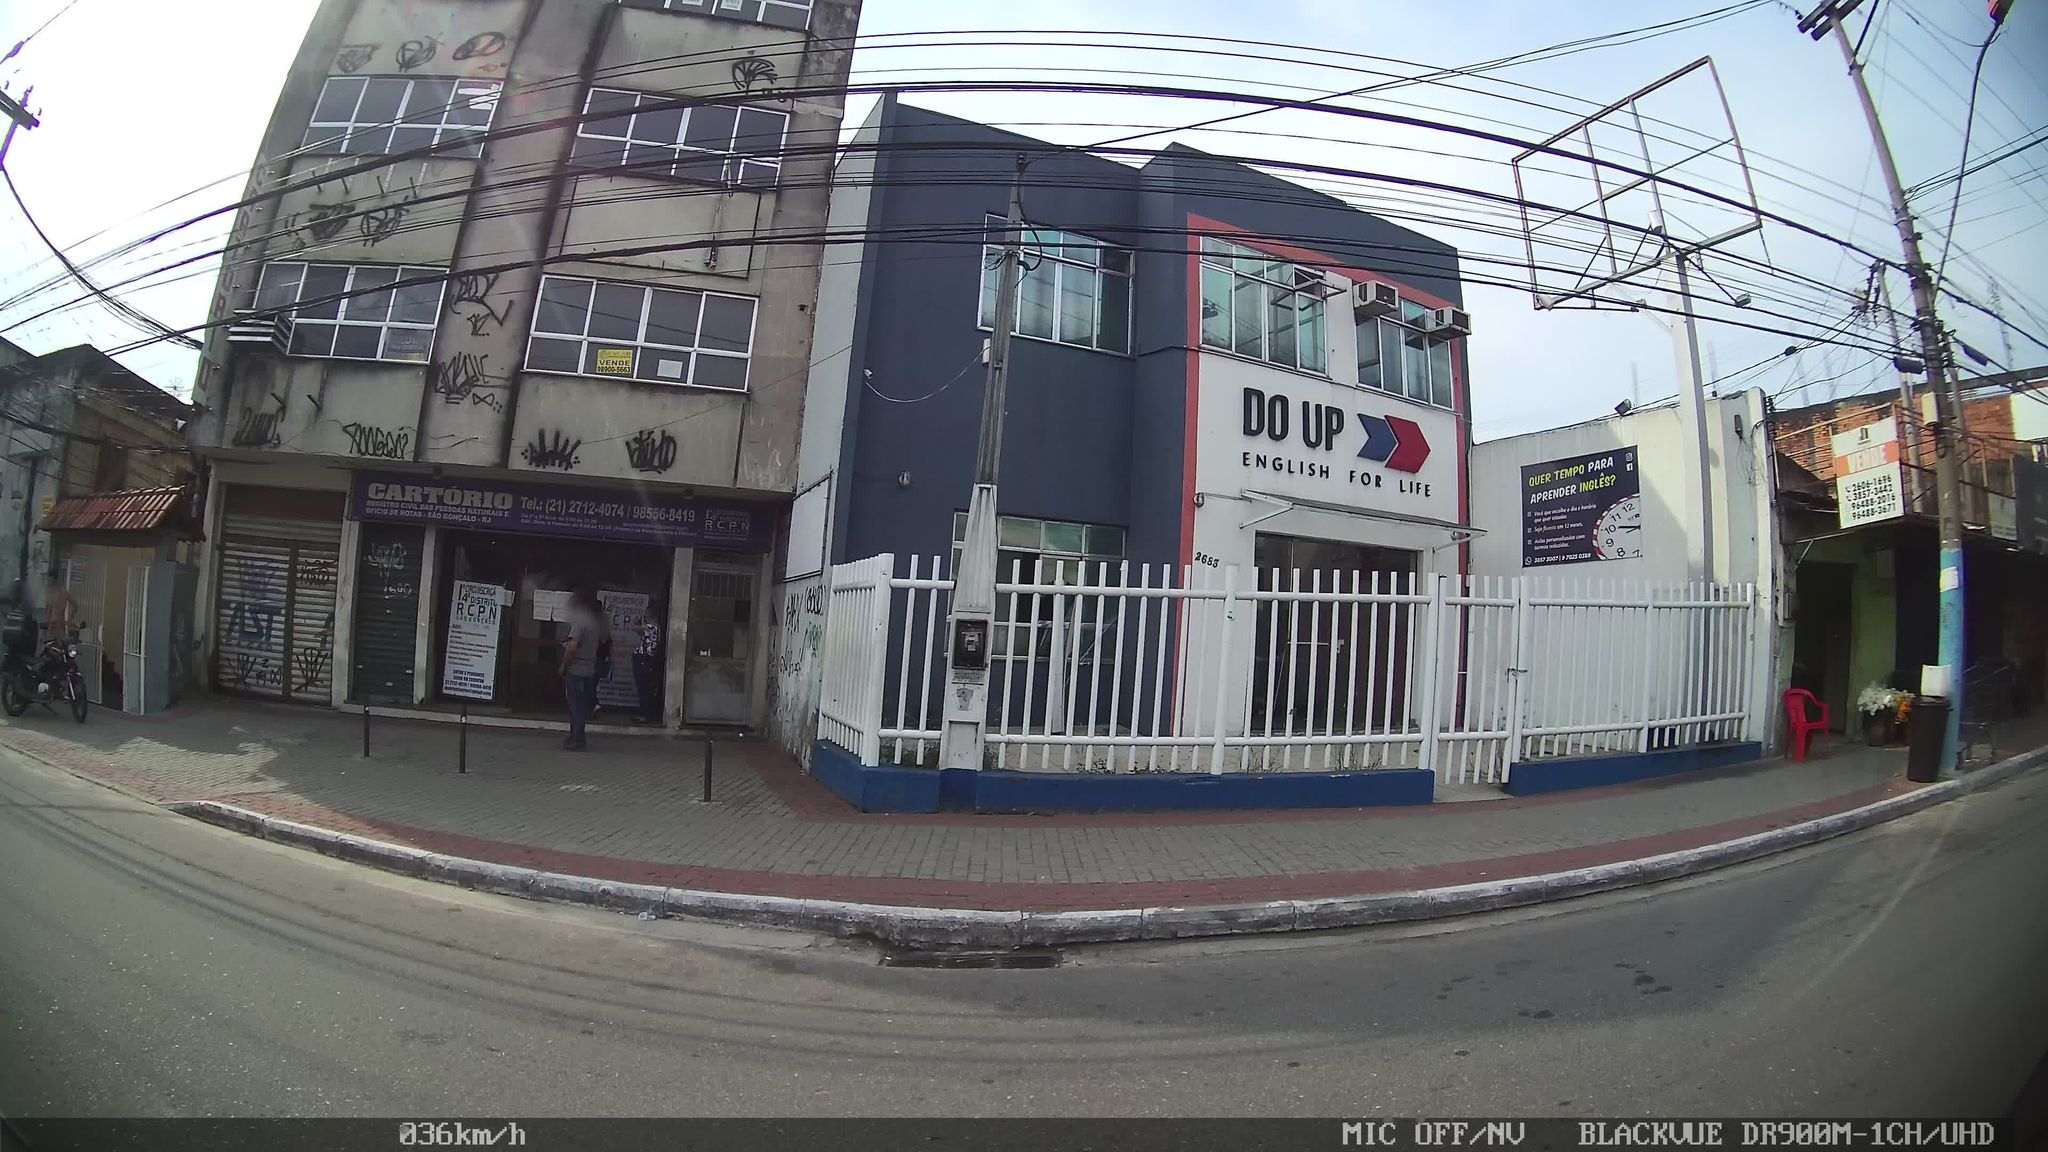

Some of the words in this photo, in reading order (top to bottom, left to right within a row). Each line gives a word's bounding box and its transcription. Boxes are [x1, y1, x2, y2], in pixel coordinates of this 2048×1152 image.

[1243, 387, 1289, 441] DO
[1302, 401, 1344, 450] UP
[1243, 451, 1330, 479] ENGLISH
[1349, 470, 1382, 488] FOR
[1399, 479, 1431, 497] LIFE
[1528, 474, 1552, 487] QUER
[1554, 465, 1584, 481] TEMPO
[1587, 456, 1614, 472] PARA
[368, 482, 513, 509] CARTÓRIO
[1530, 484, 1577, 504] APRENDER
[1579, 472, 1616, 493] INGLÊS?
[365, 506, 388, 515] OFÍCIO
[427, 511, 442, 519] SÃO
[443, 513, 476, 522] GONÇALO
[481, 515, 491, 523] RJ
[366, 500, 400, 509] REGISTRO
[400, 502, 419, 510] CIVIL
[434, 505, 466, 514] PESSOAS
[467, 507, 503, 517] NATURAIS
[520, 496, 543, 511] Tel.:
[545, 498, 566, 515] (21)
[568, 500, 625, 518] 2712-4074
[632, 505, 696, 522] 98556-8419
[1622, 502, 1635, 513] 12
[1610, 512, 1622, 522] 11
[1604, 524, 1617, 535] 10
[1605, 538, 1614, 547] 9
[1195, 551, 1220, 569] 2683
[1616, 547, 1625, 557] 8
[456, 602, 497, 620] RCPN
